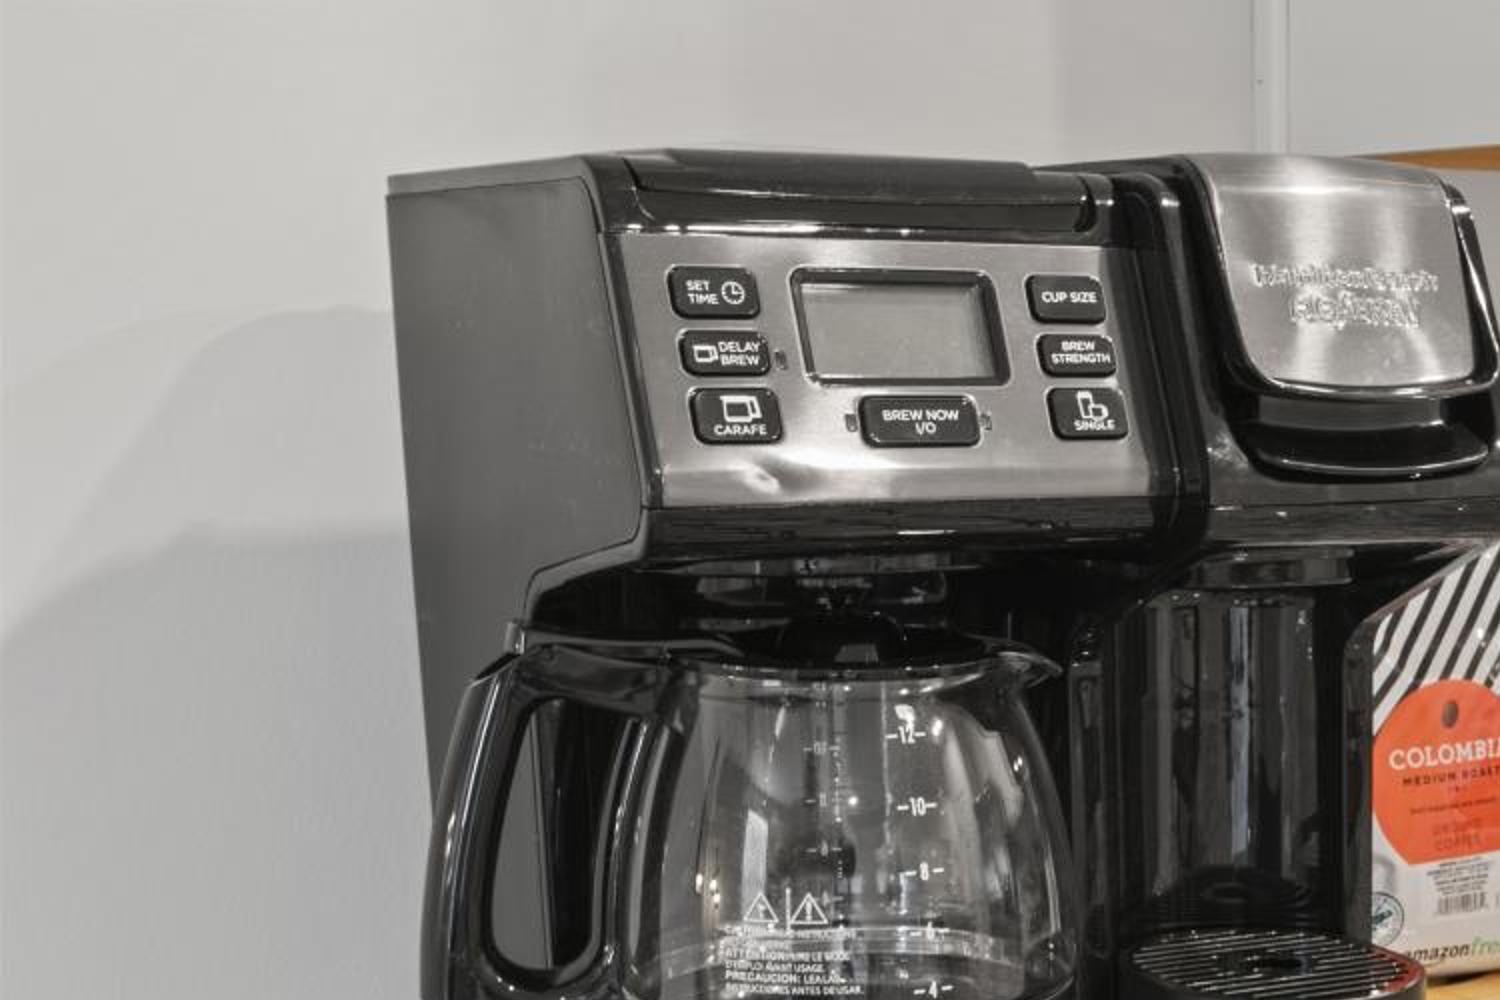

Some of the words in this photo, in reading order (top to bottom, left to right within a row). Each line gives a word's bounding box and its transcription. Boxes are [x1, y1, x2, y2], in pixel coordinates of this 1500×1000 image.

[685, 279, 710, 292] SET
[687, 292, 720, 305] TIME
[1041, 291, 1068, 304] CUP
[1070, 291, 1098, 304] SIZE
[717, 341, 761, 353] DELAY
[1061, 340, 1096, 351] BREW
[720, 353, 760, 366] BREW
[1050, 352, 1112, 364] STRENGTH
[882, 409, 924, 422] BREW
[926, 409, 960, 422] NOW
[713, 423, 768, 436] CARAFE
[1073, 419, 1116, 432] SINGLE
[898, 724, 916, 745] 12
[1402, 771, 1457, 787] MEDIUM
[909, 796, 926, 817] 10
[919, 861, 930, 881] 8
[928, 981, 938, 999] 4
